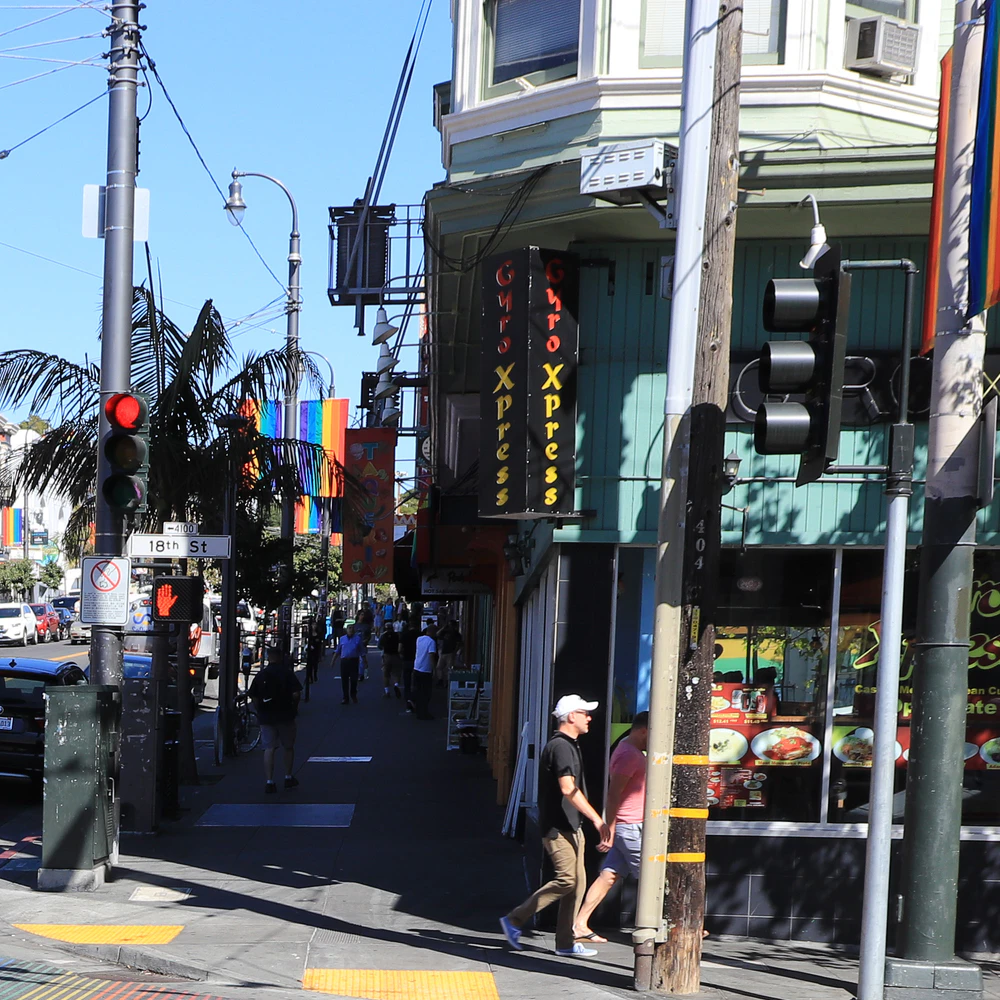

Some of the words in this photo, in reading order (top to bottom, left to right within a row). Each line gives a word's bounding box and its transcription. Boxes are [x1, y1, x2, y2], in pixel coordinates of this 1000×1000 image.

[495, 259, 516, 355] Gyro
[545, 258, 565, 353] Gyro
[492, 361, 516, 507] Xpress
[541, 362, 565, 507] Xpress
[149, 540, 180, 553] 18th
[189, 540, 208, 554] St
[174, 524, 194, 533] 4100
